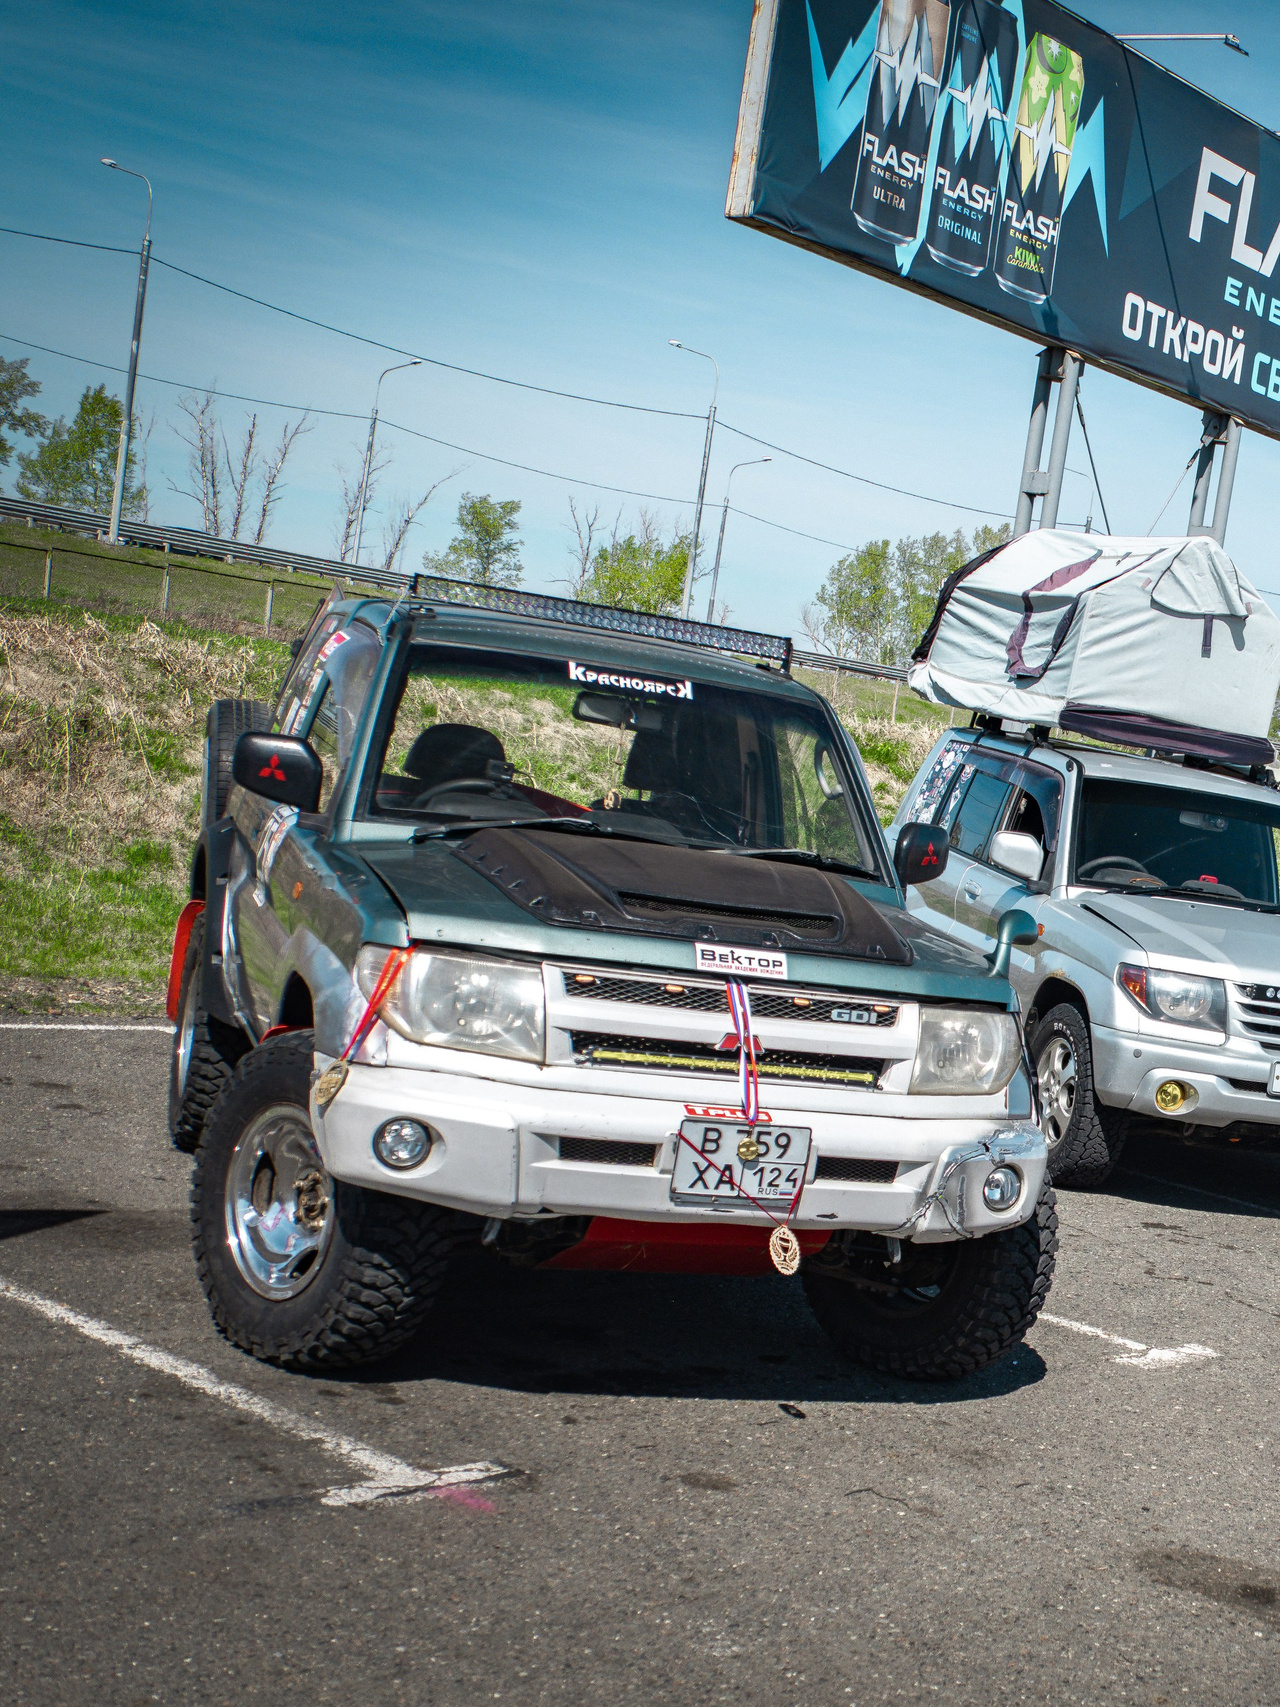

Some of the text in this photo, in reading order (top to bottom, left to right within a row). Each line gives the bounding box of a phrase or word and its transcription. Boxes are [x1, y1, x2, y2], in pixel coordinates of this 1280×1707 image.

[863, 132, 927, 184] FLASH
[870, 164, 913, 190] ENERGY
[934, 166, 996, 215] FLASH
[872, 185, 906, 211] ULTRA
[942, 199, 984, 222] ENERGY
[937, 215, 982, 245] ORIGINAL
[1002, 198, 1059, 245] FLASH
[1009, 228, 1048, 251] ENERGY
[1122, 292, 1246, 385] ОТКРОЙ
[831, 1008, 877, 1024] GDI
[701, 1127, 722, 1154] В
[688, 1161, 798, 1191] ХА 124
[758, 1187, 778, 1196] RUS
